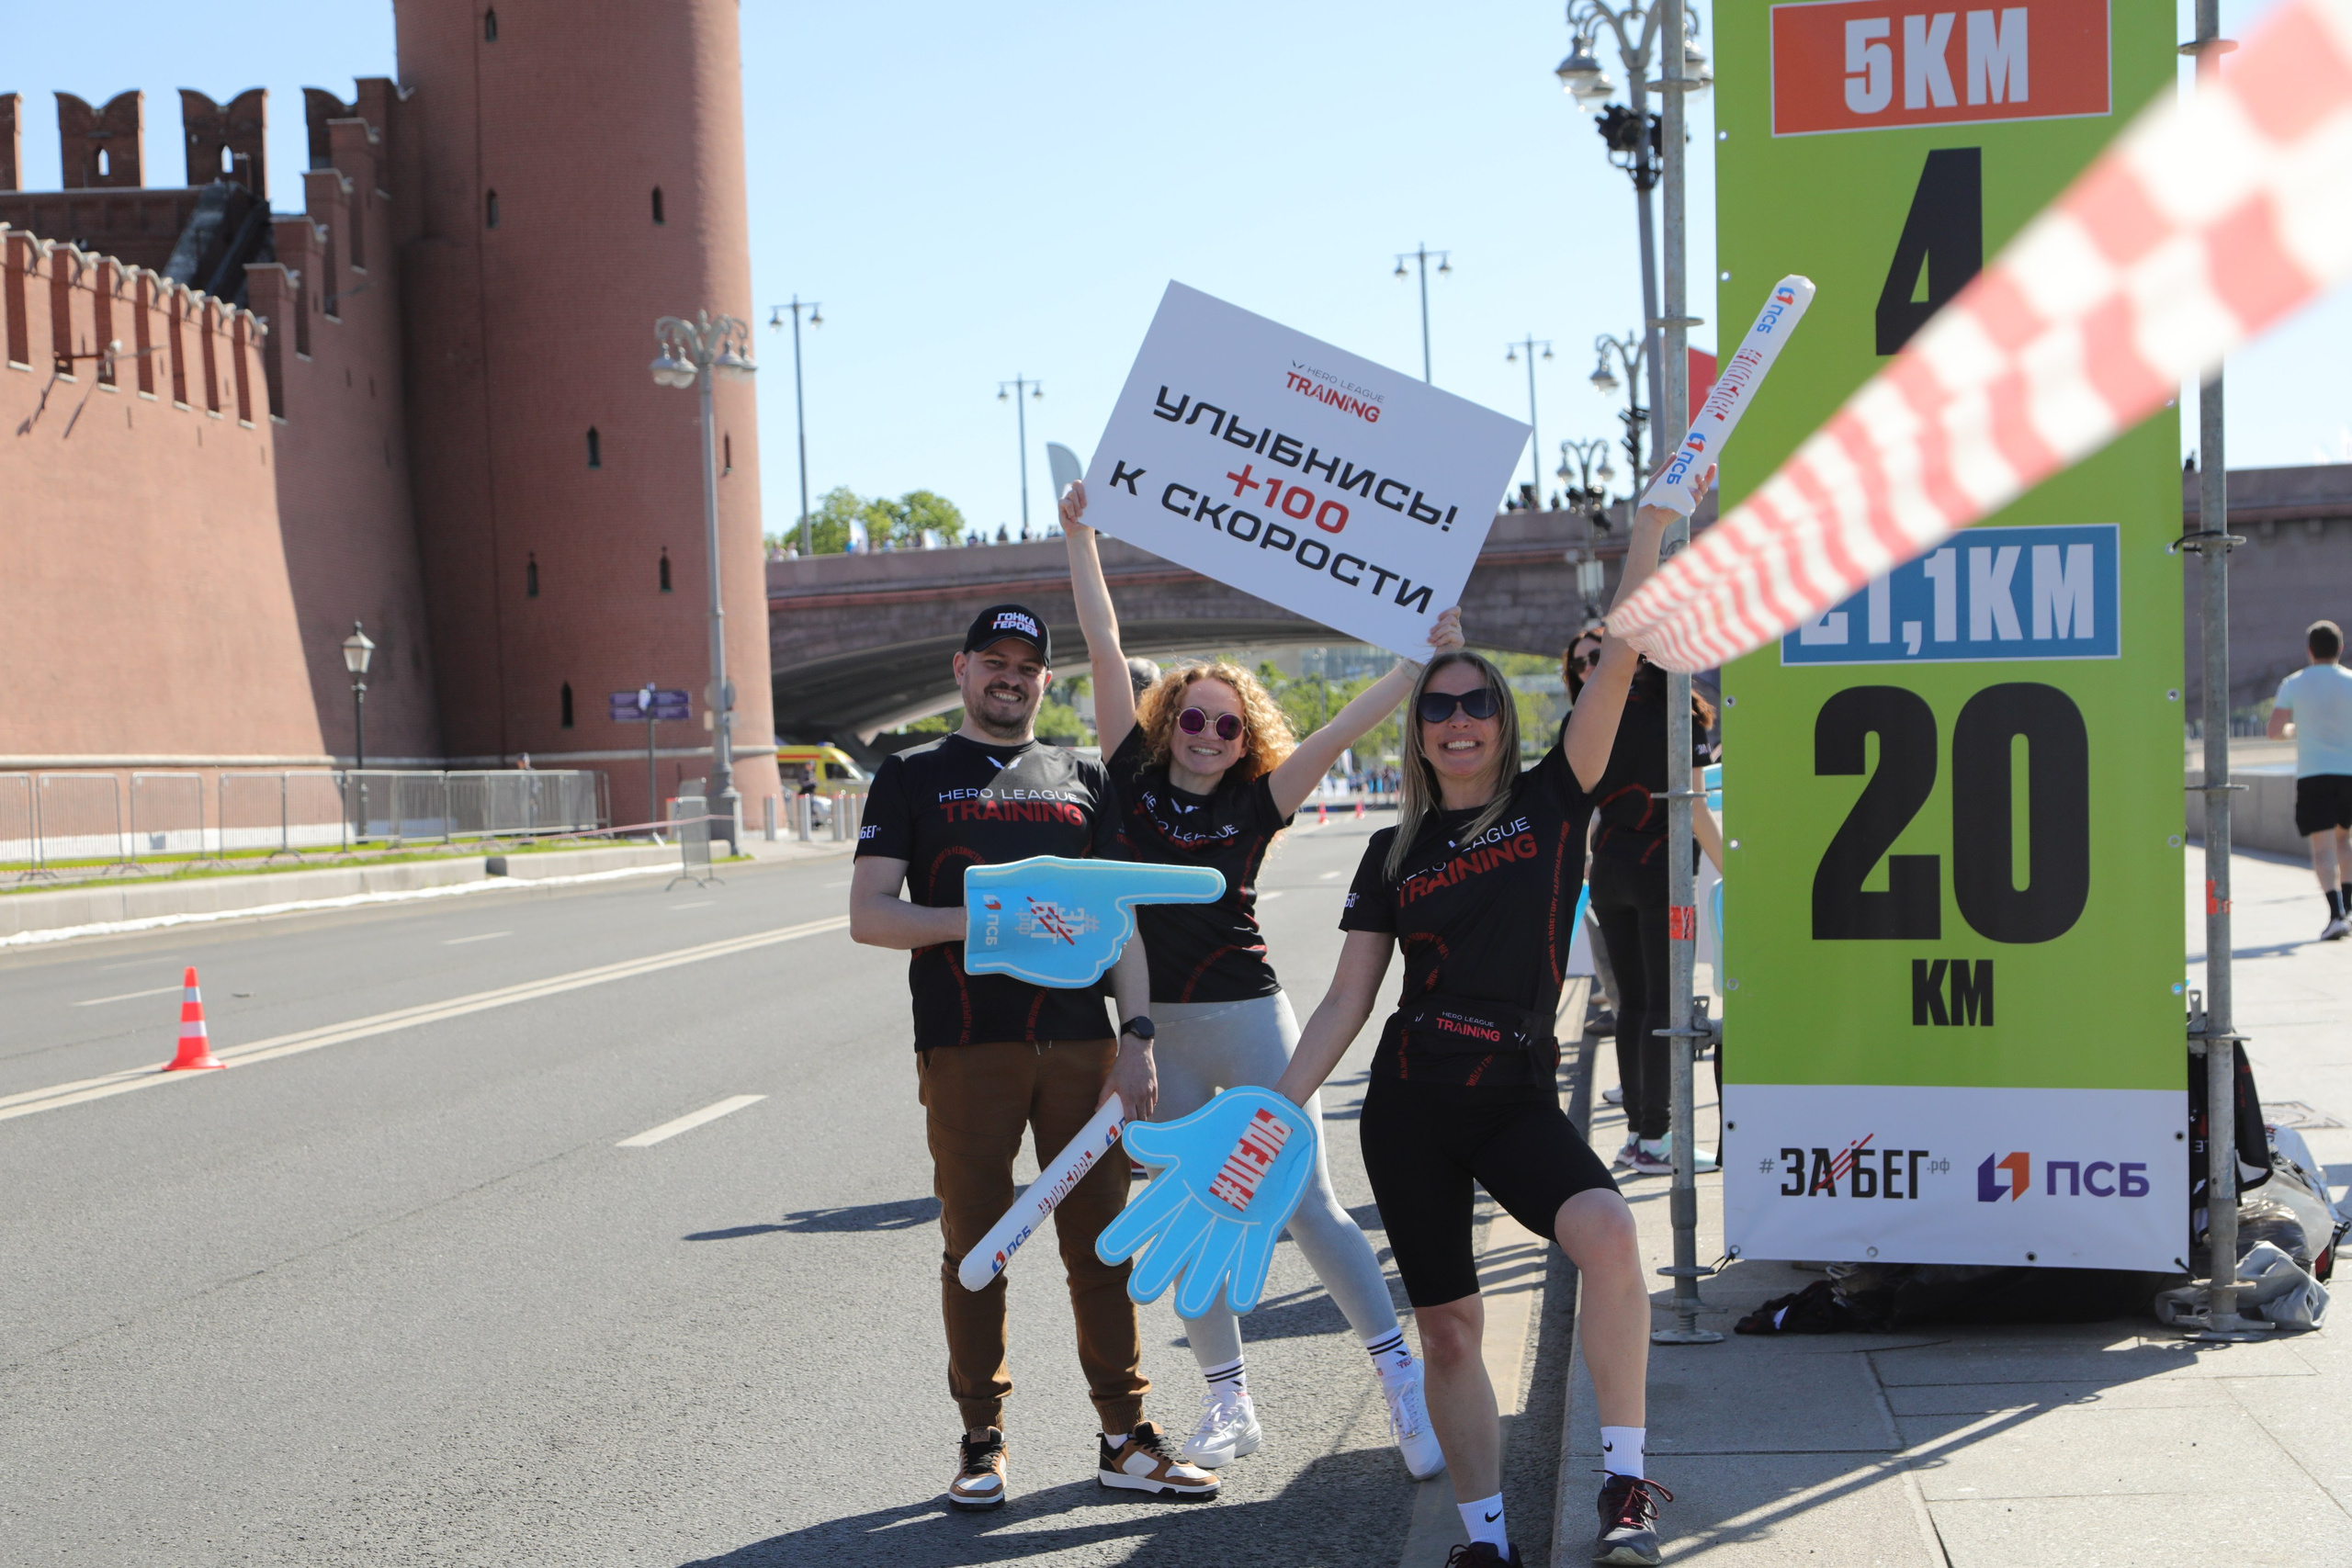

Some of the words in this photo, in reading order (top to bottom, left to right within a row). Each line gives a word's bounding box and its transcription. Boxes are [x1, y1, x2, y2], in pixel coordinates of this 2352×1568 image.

[1845, 7, 2029, 114] 5КМ
[1876, 146, 1983, 355] 4
[1757, 304, 1784, 334] ПСБ
[1286, 371, 1382, 423] TRAINING
[1307, 367, 1338, 387] HERO
[1340, 378, 1385, 403] LEAGUE
[1154, 385, 1459, 533] УЛЫБНИСЬ!
[1667, 451, 1693, 485] ПСБ
[1227, 464, 1350, 534] +100
[1110, 460, 1147, 497] К
[1161, 482, 1434, 614] СКОРОСТИ
[992, 620, 1038, 637] ГЕРОЕВ
[997, 612, 1036, 628] ГОНКА
[939, 787, 993, 803] HERO
[1001, 788, 1080, 805] LEAGUE
[940, 799, 1082, 827] TRAINING
[1812, 682, 2090, 944] 20
[1398, 834, 1538, 908] TRAINING
[985, 914, 1000, 946] ПСБ
[1912, 959, 1994, 1026] КМ
[1436, 1018, 1501, 1043] TRAINING
[1442, 1011, 1463, 1021] HERO
[1464, 1016, 1495, 1028] LEAGUE
[1208, 1108, 1294, 1213] #ЦЕЛЬ
[2046, 1160, 2150, 1198] ПСБ
[1006, 1224, 1032, 1257] ПСБ
